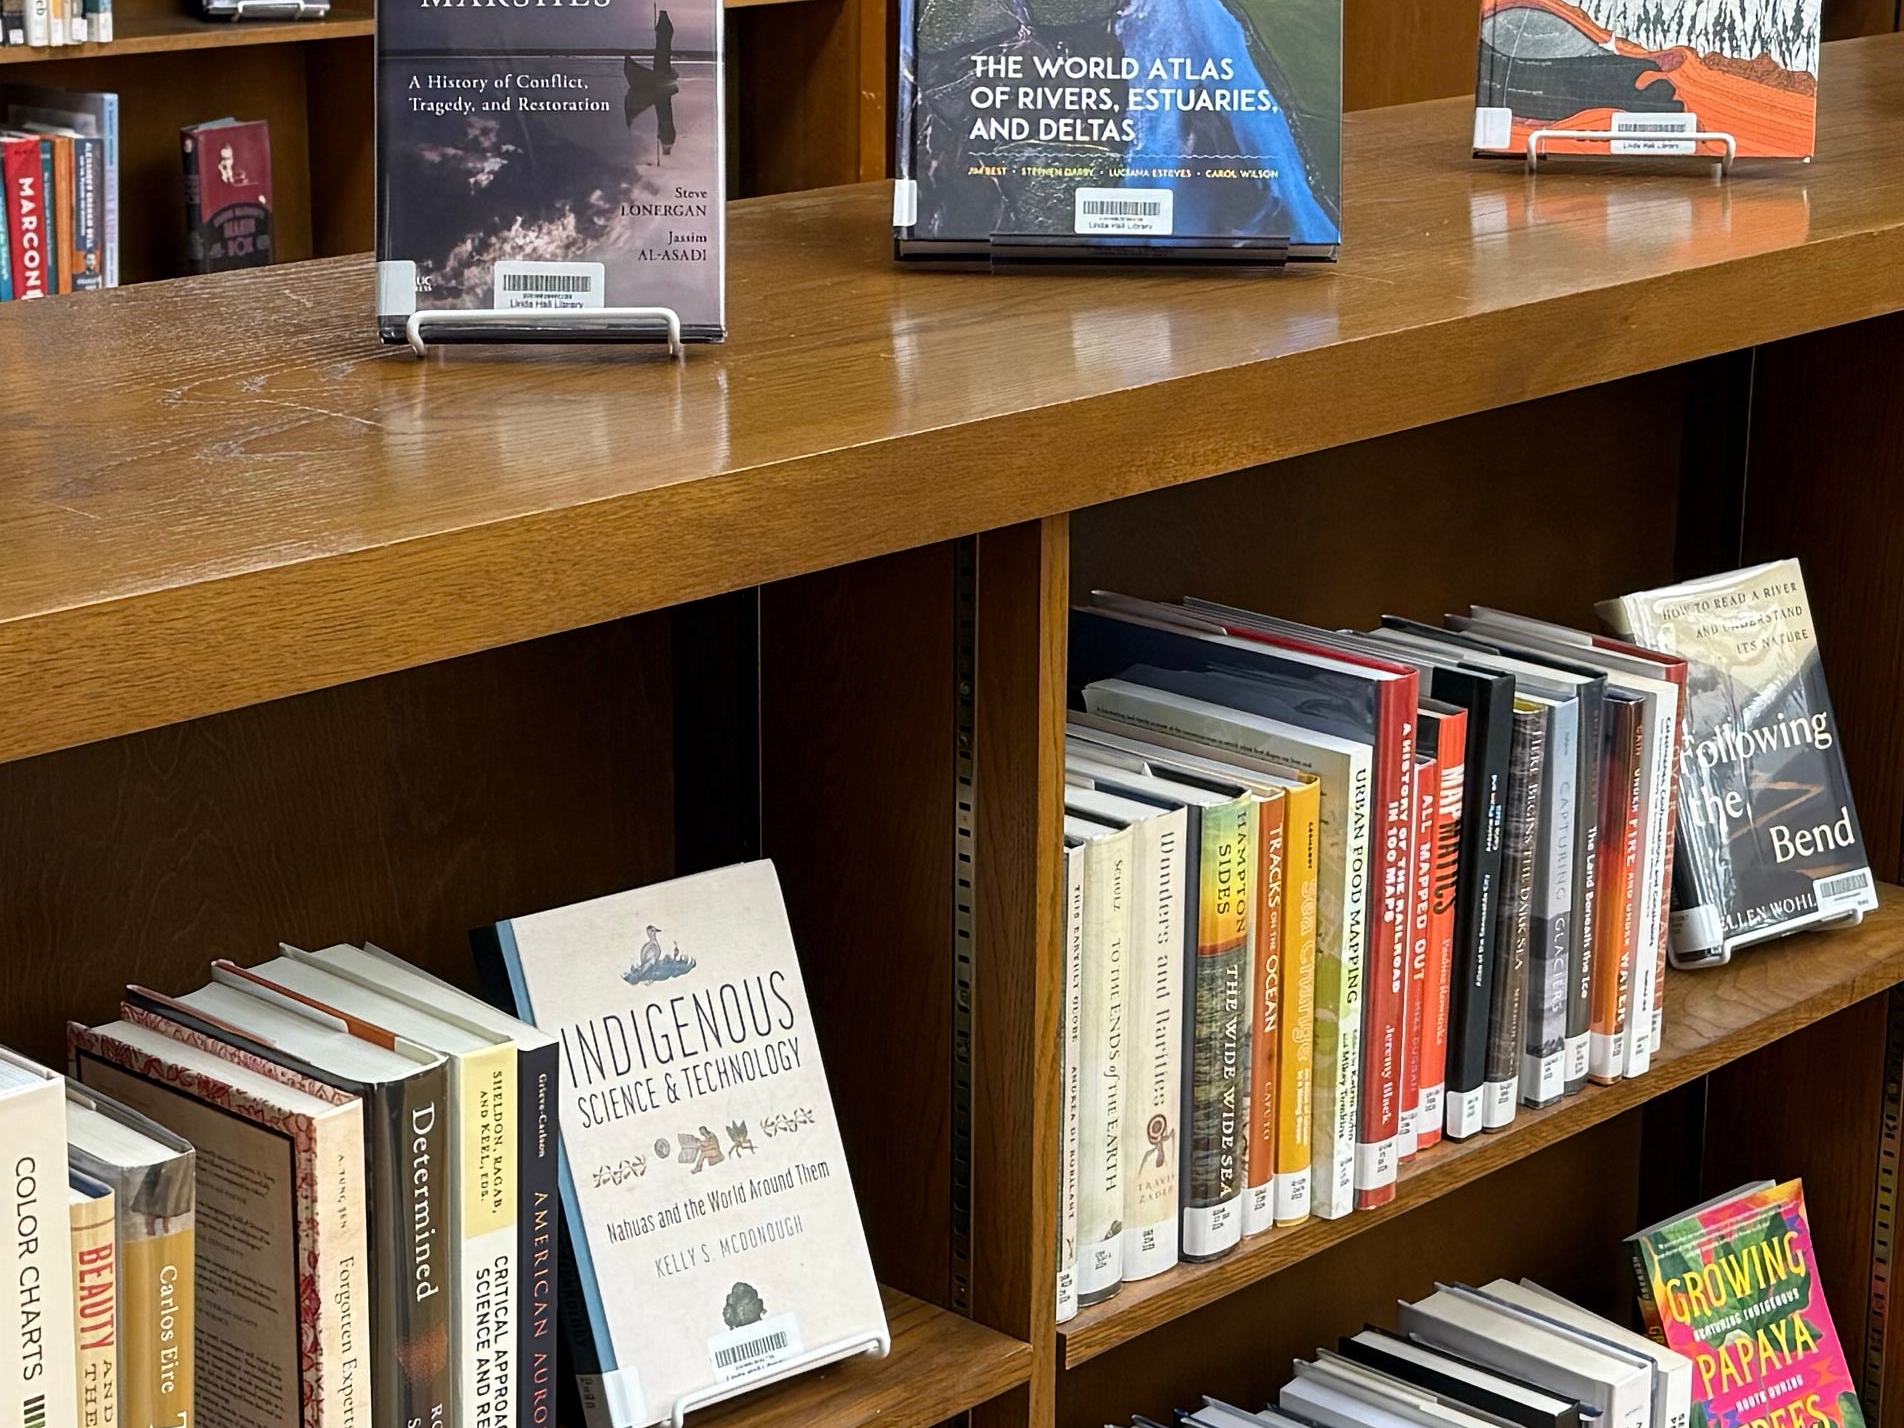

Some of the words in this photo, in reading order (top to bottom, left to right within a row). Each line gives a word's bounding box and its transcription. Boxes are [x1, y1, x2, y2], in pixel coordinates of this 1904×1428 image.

[408, 75, 421, 89] A
[427, 75, 488, 94] History
[493, 73, 512, 90] of
[516, 73, 589, 92] Conflict,
[970, 55, 1023, 79] THE
[1033, 55, 1140, 80] WORLD
[1147, 57, 1234, 81] ATLAS
[408, 97, 475, 115] Tragedy,
[481, 96, 511, 112] and
[518, 96, 611, 113] Restoration
[969, 118, 1030, 141] AND
[1039, 118, 1136, 142] DELTAS
[970, 86, 1010, 110] OF
[1017, 86, 1120, 113] RIVERS,
[1128, 88, 1280, 114] ESTUARIES,
[620, 203, 708, 218] LONERGAN
[674, 186, 708, 200] Steve
[638, 247, 708, 262] AL-ASADI
[667, 230, 708, 247] Jassim
[1680, 710, 1834, 774] Following
[1354, 767, 1367, 838] URBAN
[1688, 791, 1744, 824] the
[1770, 806, 1855, 864] Bend
[1351, 840, 1364, 903] FOOD
[1346, 907, 1363, 1006] MAPPING
[560, 970, 796, 1089] INDIGENOUS
[577, 1078, 661, 1129] SCIENCE
[663, 1072, 679, 1102] &
[680, 1037, 802, 1098] TECHNOLOGY
[14, 1155, 40, 1261] COLOR
[410, 1101, 440, 1303] Determined
[606, 1209, 656, 1245] Nahuas
[657, 1201, 681, 1231] and
[683, 1195, 706, 1223] the
[708, 1181, 746, 1213] World
[750, 1170, 795, 1201] Around
[796, 1160, 830, 1189] Them
[655, 1244, 699, 1279] KELLY
[701, 1243, 715, 1264] S.
[719, 1214, 804, 1257] MCDONOUGH
[1665, 1230, 1806, 1325] GROWING
[20, 1266, 45, 1381] CHARTS
[1696, 1312, 1819, 1401] PAPAYA
